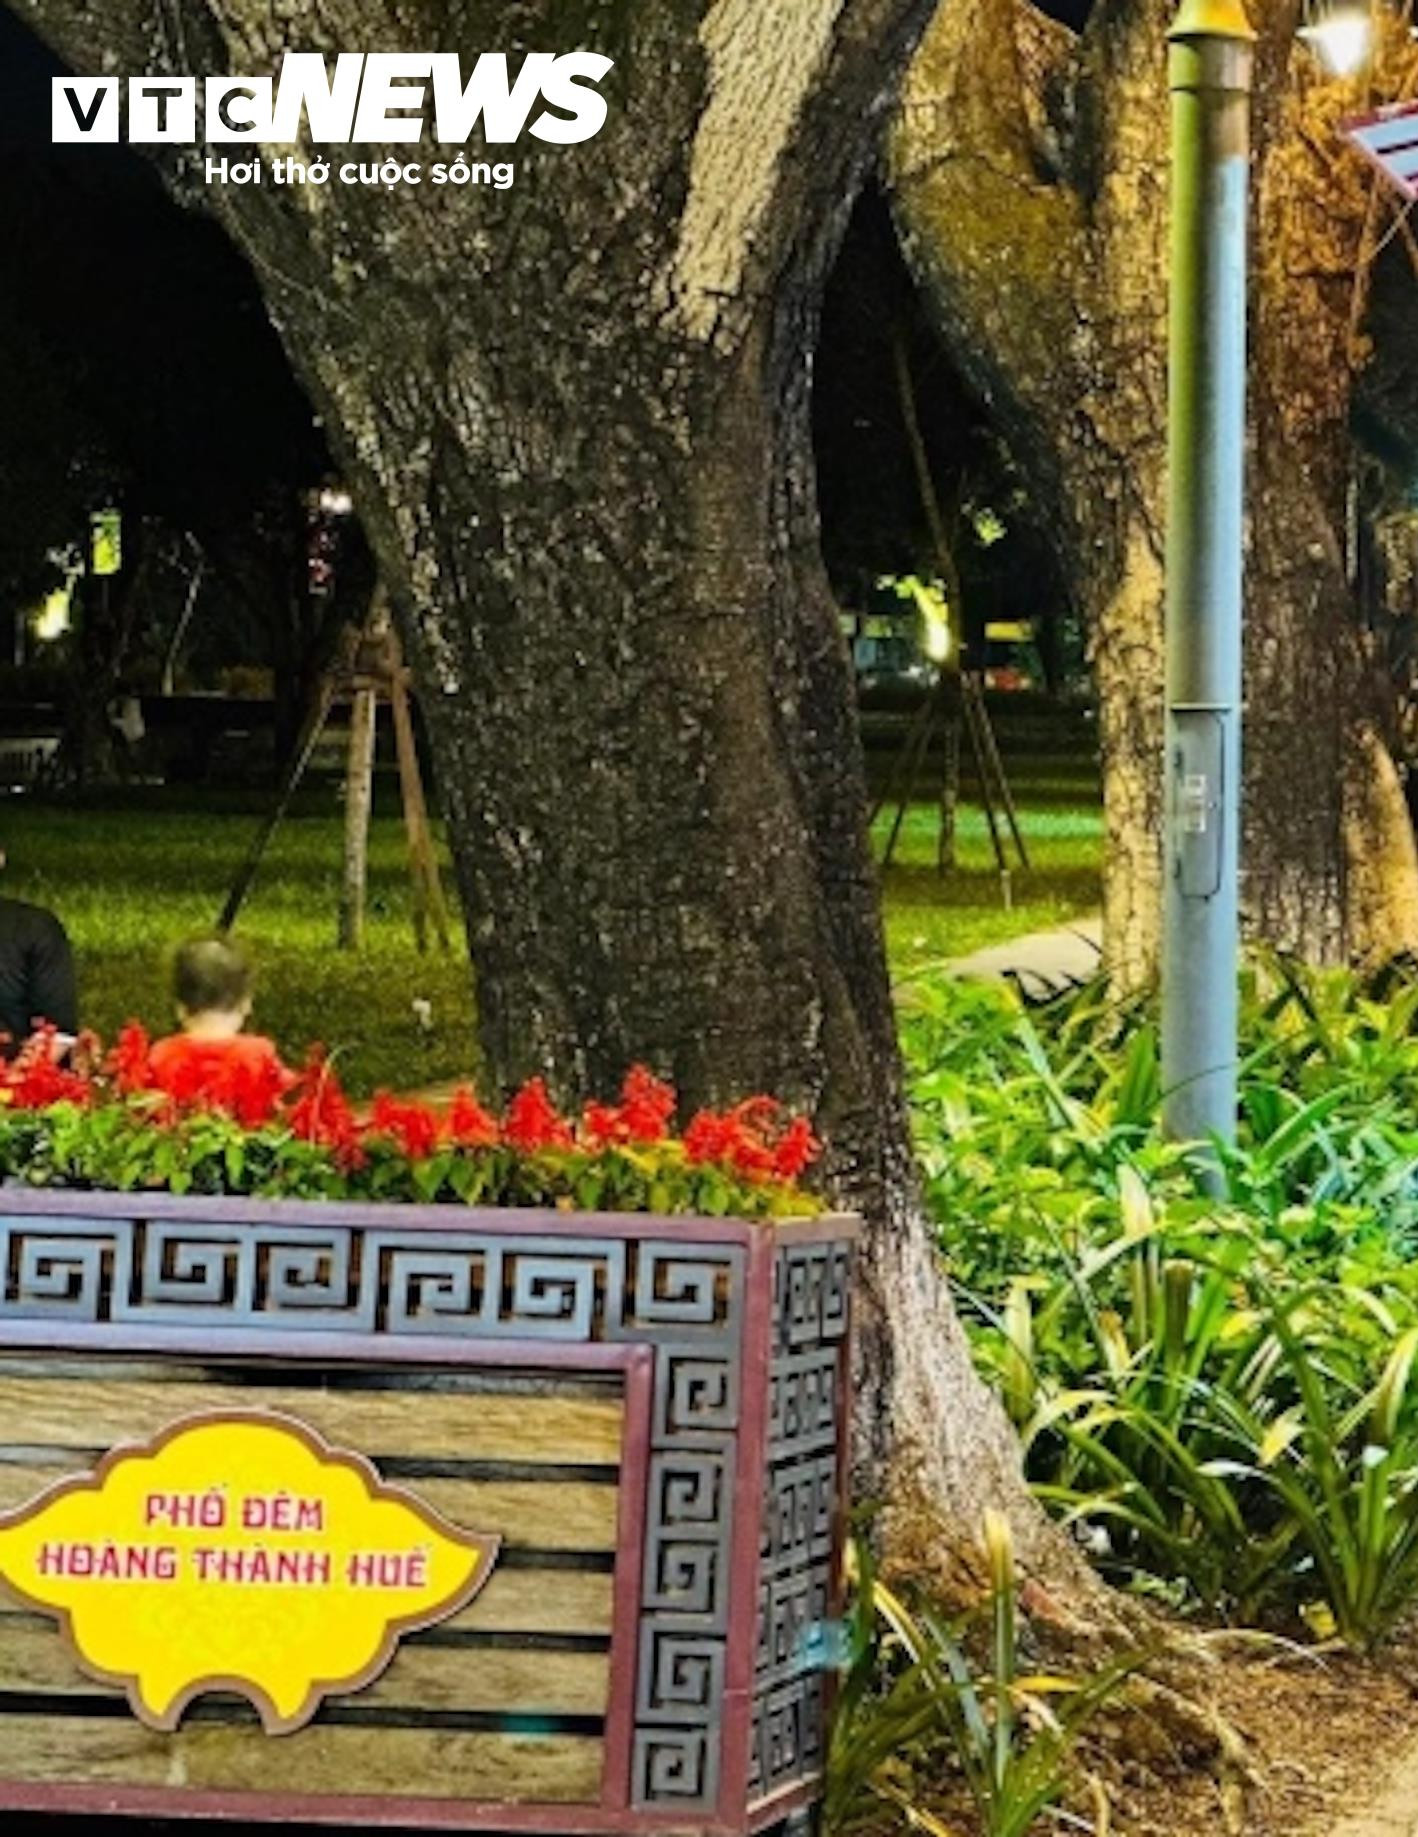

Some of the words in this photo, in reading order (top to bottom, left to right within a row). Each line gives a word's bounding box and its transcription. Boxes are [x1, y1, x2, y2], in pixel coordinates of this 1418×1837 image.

[145, 1482, 229, 1528] PHỐ
[242, 1490, 323, 1531] ĐÊM
[37, 1539, 177, 1580] HOÀNG
[192, 1542, 330, 1584] THÀNH
[346, 1543, 432, 1588] HUẾ
